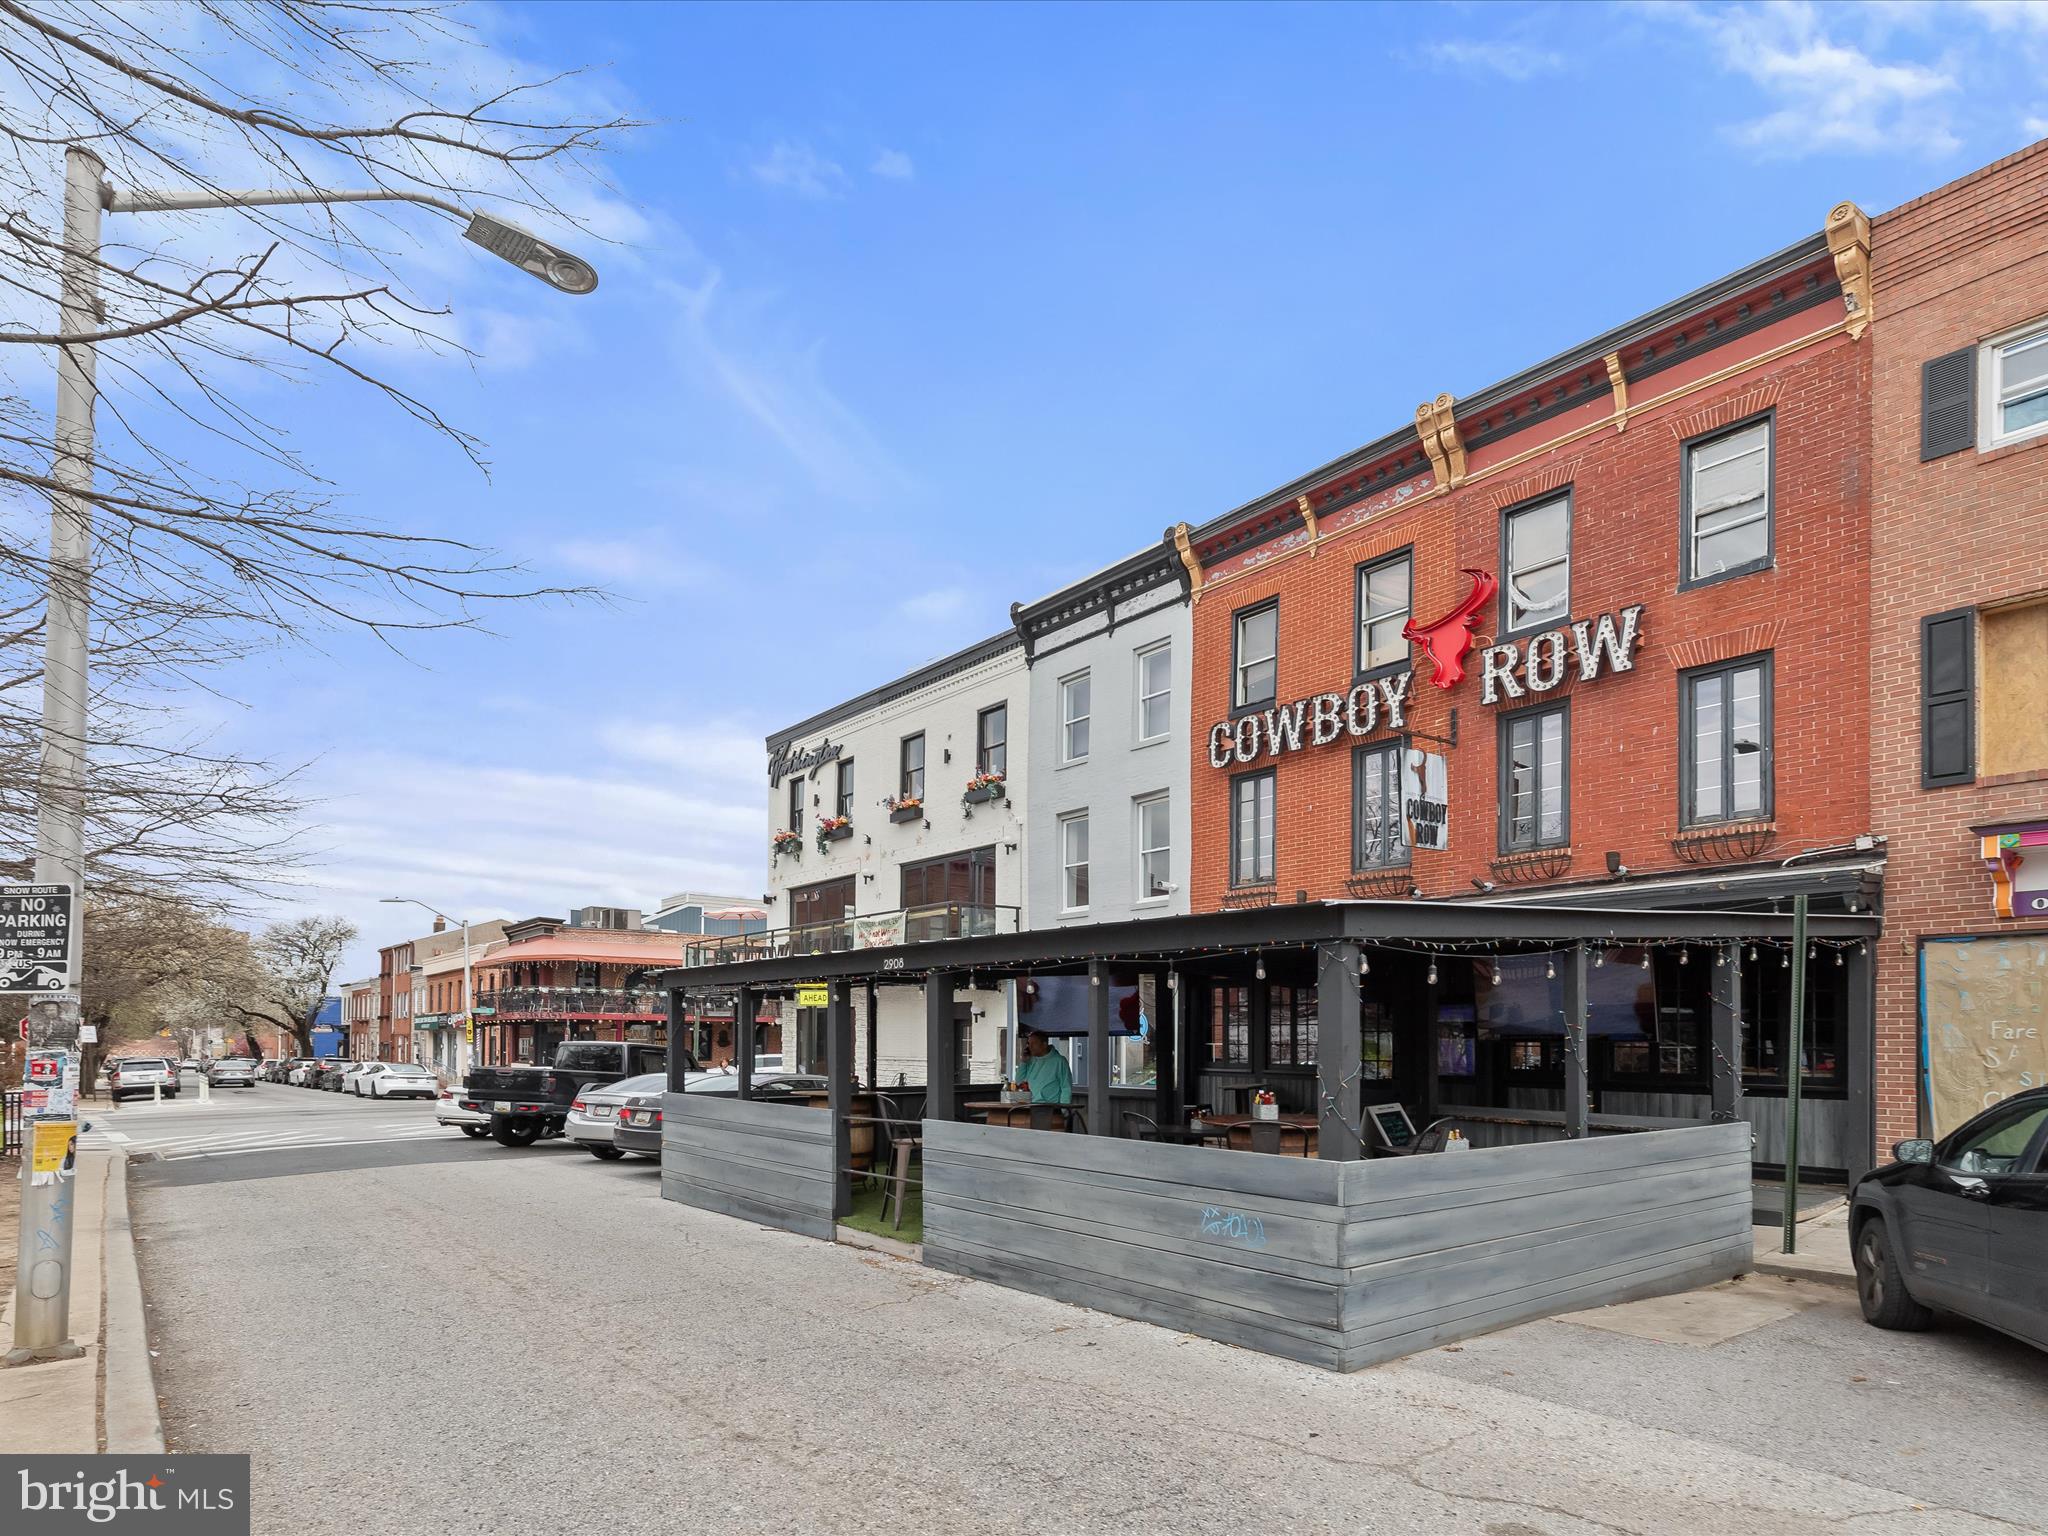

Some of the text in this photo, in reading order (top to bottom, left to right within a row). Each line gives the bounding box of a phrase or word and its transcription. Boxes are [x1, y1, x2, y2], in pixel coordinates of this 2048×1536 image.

[1207, 604, 1645, 769] COWBOY ROW
[1407, 798, 1448, 825] COWBOY
[1416, 822, 1439, 847] ROW
[3, 886, 58, 895] SNOW ROUTE
[20, 897, 46, 912] NO
[17, 930, 46, 938] DURING
[0, 938, 65, 947] NOW EMERGENCY
[37, 947, 45, 958] 9
[46, 949, 61, 958] AM
[883, 957, 904, 970] 2908
[803, 994, 827, 1002] AHEAD
[1992, 1020, 2038, 1040] Fare
